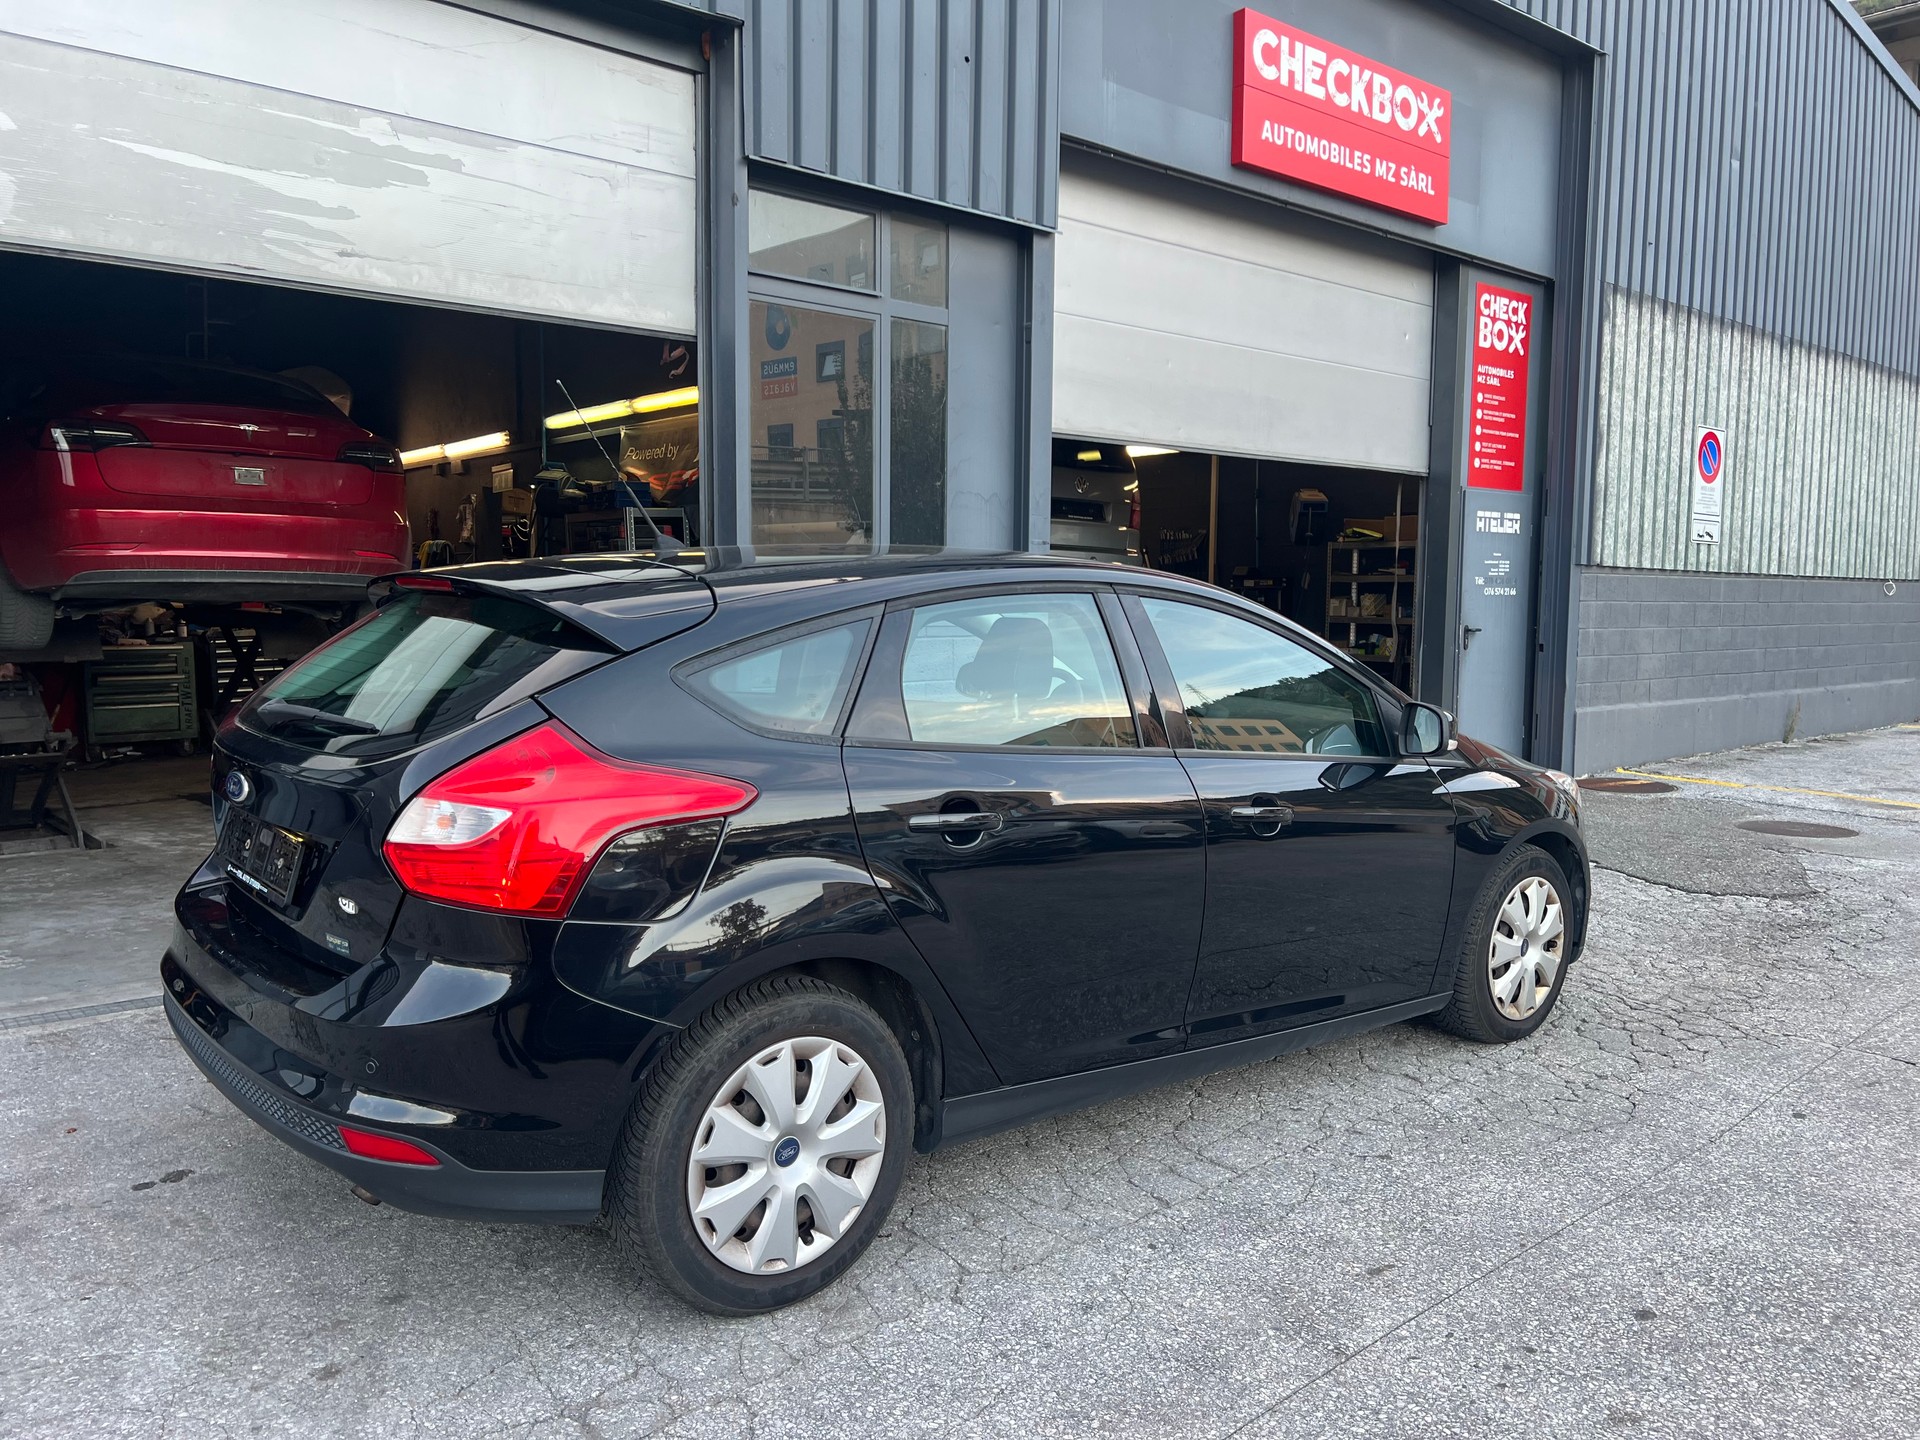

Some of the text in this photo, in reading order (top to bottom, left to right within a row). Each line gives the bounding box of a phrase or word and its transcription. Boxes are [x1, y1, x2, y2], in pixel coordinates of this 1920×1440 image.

[1253, 29, 1444, 143] CHECKBOX
[1262, 120, 1435, 195] AUTOMOBILES MZ SÀRL
[1480, 293, 1527, 325] CHECK
[1478, 315, 1526, 356] BOX
[1477, 364, 1515, 379] AUTOMOBILES
[1477, 374, 1486, 384] MZ
[624, 443, 680, 460] Powered by
